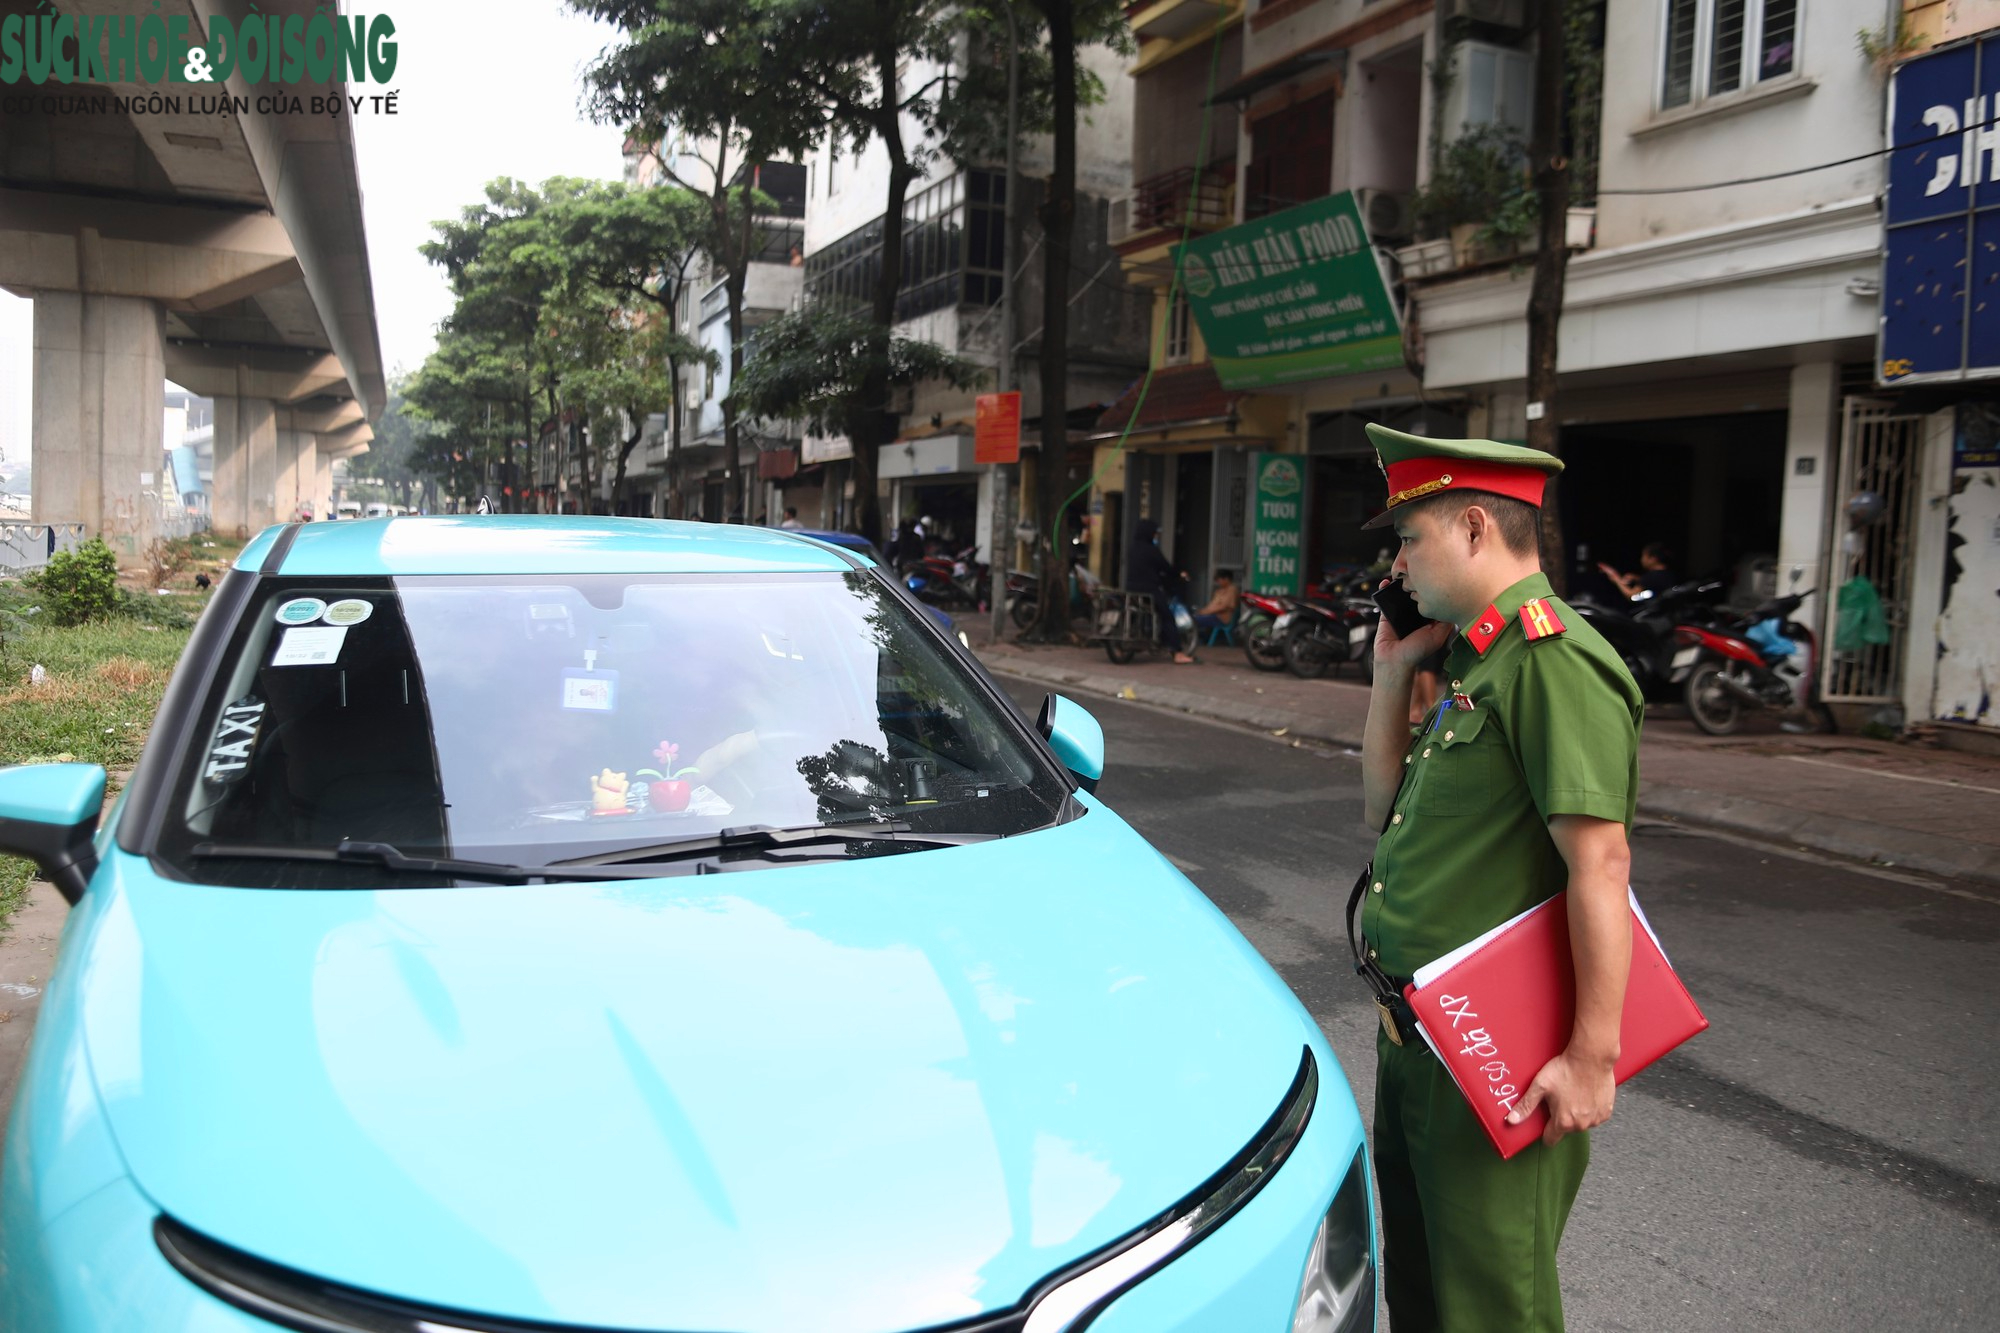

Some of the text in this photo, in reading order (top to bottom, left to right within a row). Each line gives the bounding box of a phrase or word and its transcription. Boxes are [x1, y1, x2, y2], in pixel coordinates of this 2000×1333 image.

[1296, 214, 1360, 265] FOOD
[1262, 501, 1297, 519] TƯƠI
[1256, 530, 1299, 548] NGON
[1257, 554, 1295, 576] TIỆN
[204, 702, 266, 778] TAXI
[1439, 994, 1478, 1028] XP
[1459, 1027, 1498, 1057] đã
